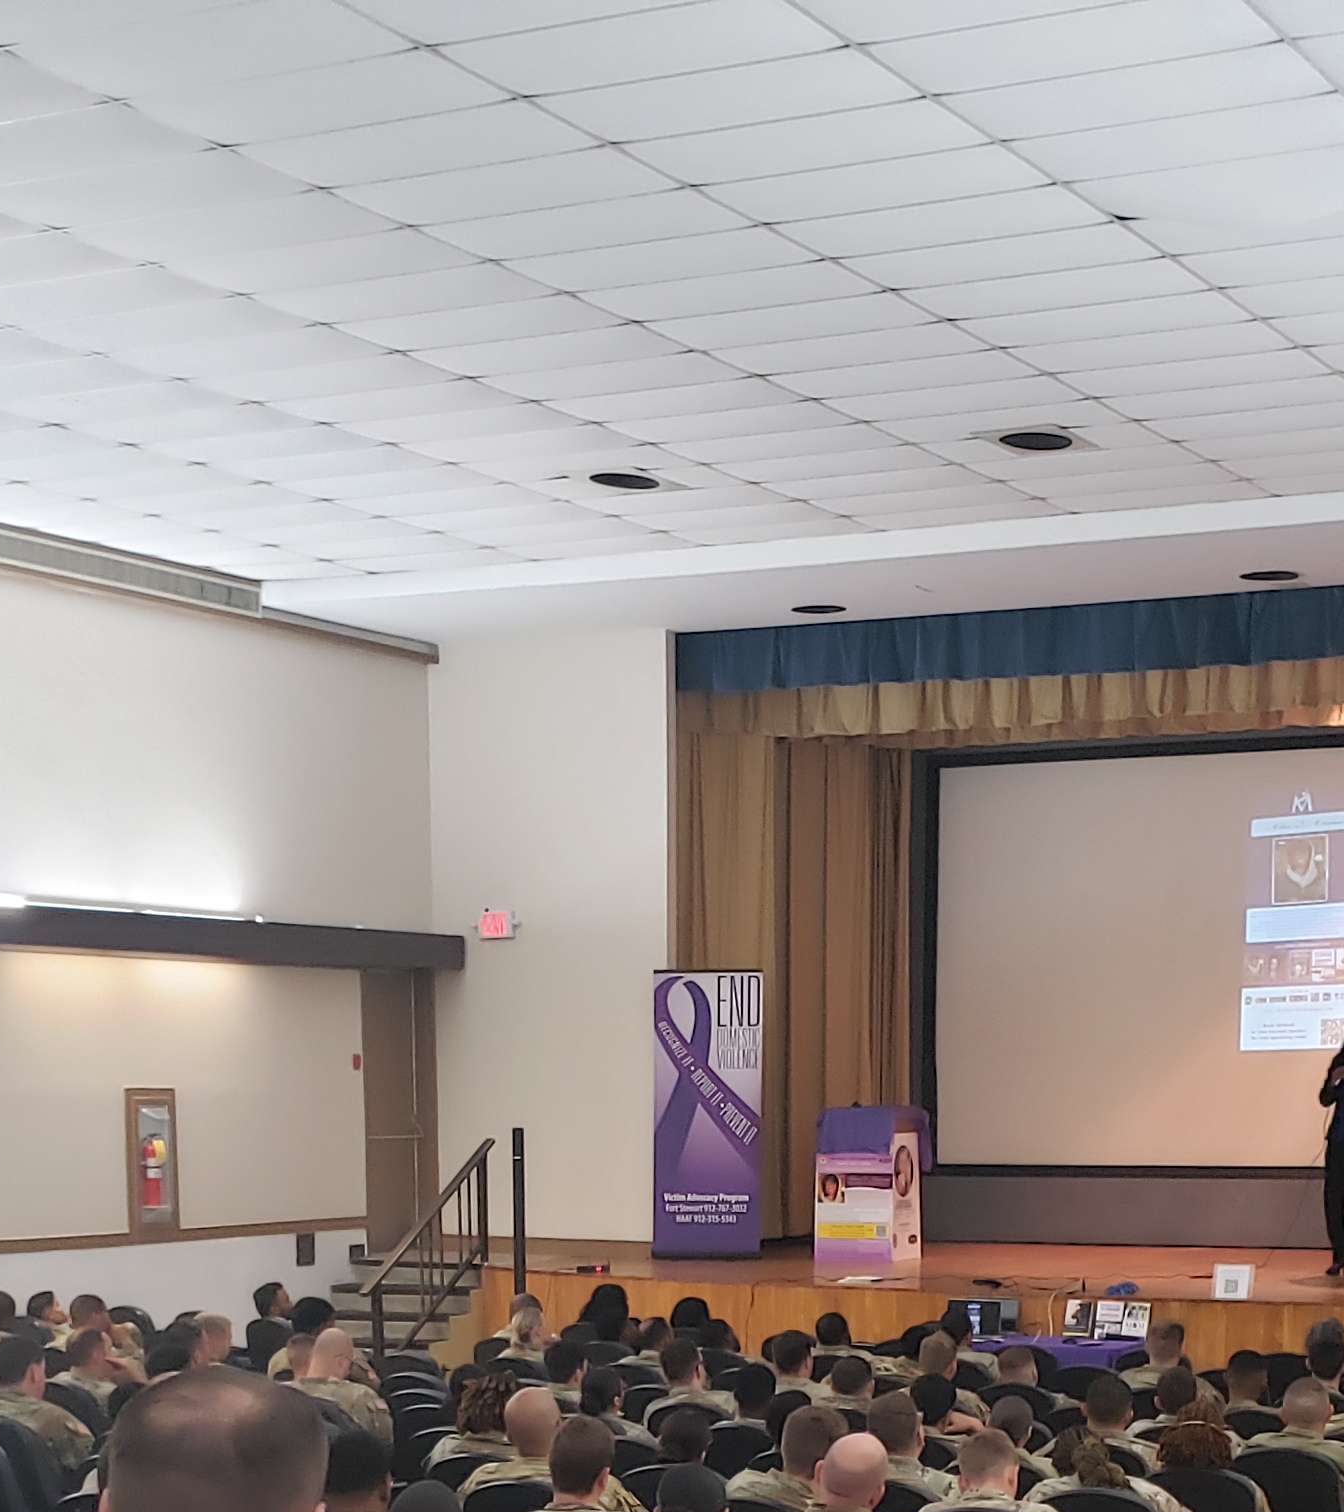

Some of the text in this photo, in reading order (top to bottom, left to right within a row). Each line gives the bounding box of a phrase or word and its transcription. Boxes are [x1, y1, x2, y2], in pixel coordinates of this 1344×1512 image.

[717, 975, 761, 1027] END
[716, 1027, 760, 1049] DOMESTIC
[716, 1049, 758, 1069] VIOLENCE
[690, 1068, 718, 1099] REPORT
[720, 1102, 751, 1138] PREVENT
[743, 1127, 758, 1146] IT
